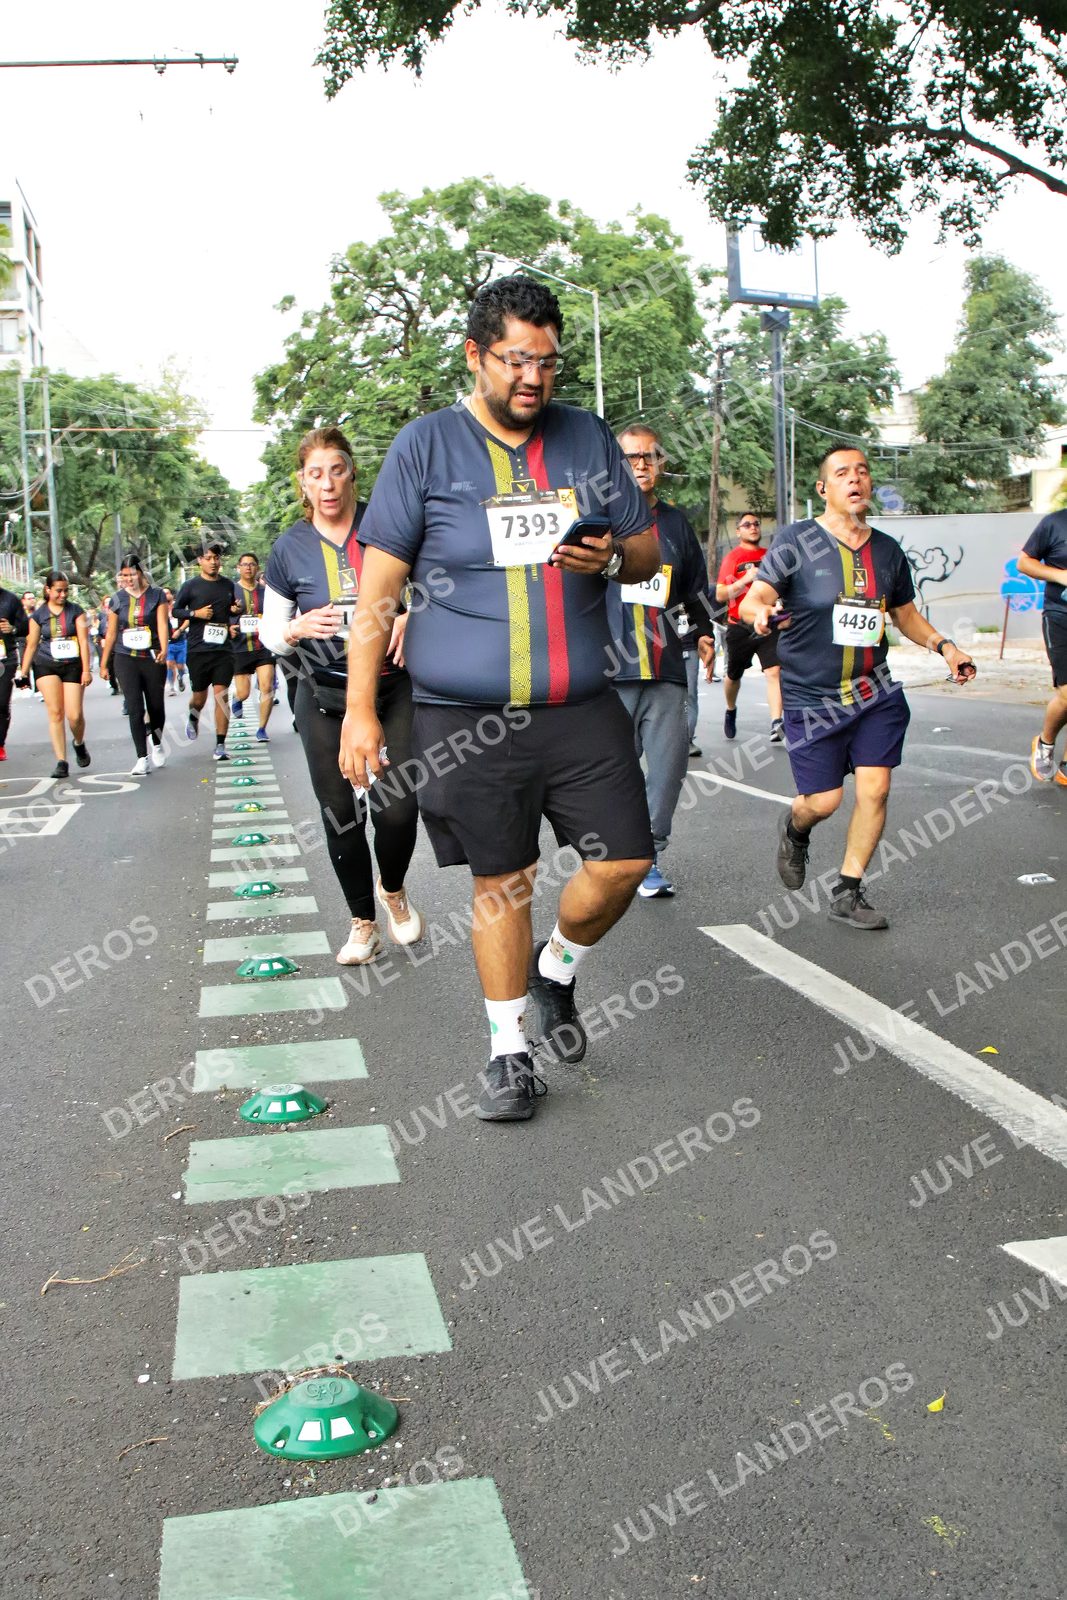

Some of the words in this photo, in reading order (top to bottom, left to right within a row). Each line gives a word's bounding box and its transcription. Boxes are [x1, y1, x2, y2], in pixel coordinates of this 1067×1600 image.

[501, 512, 560, 539] 7393
[838, 612, 877, 631] 4436
[208, 628, 224, 636] 5754
[57, 642, 71, 650] 490
